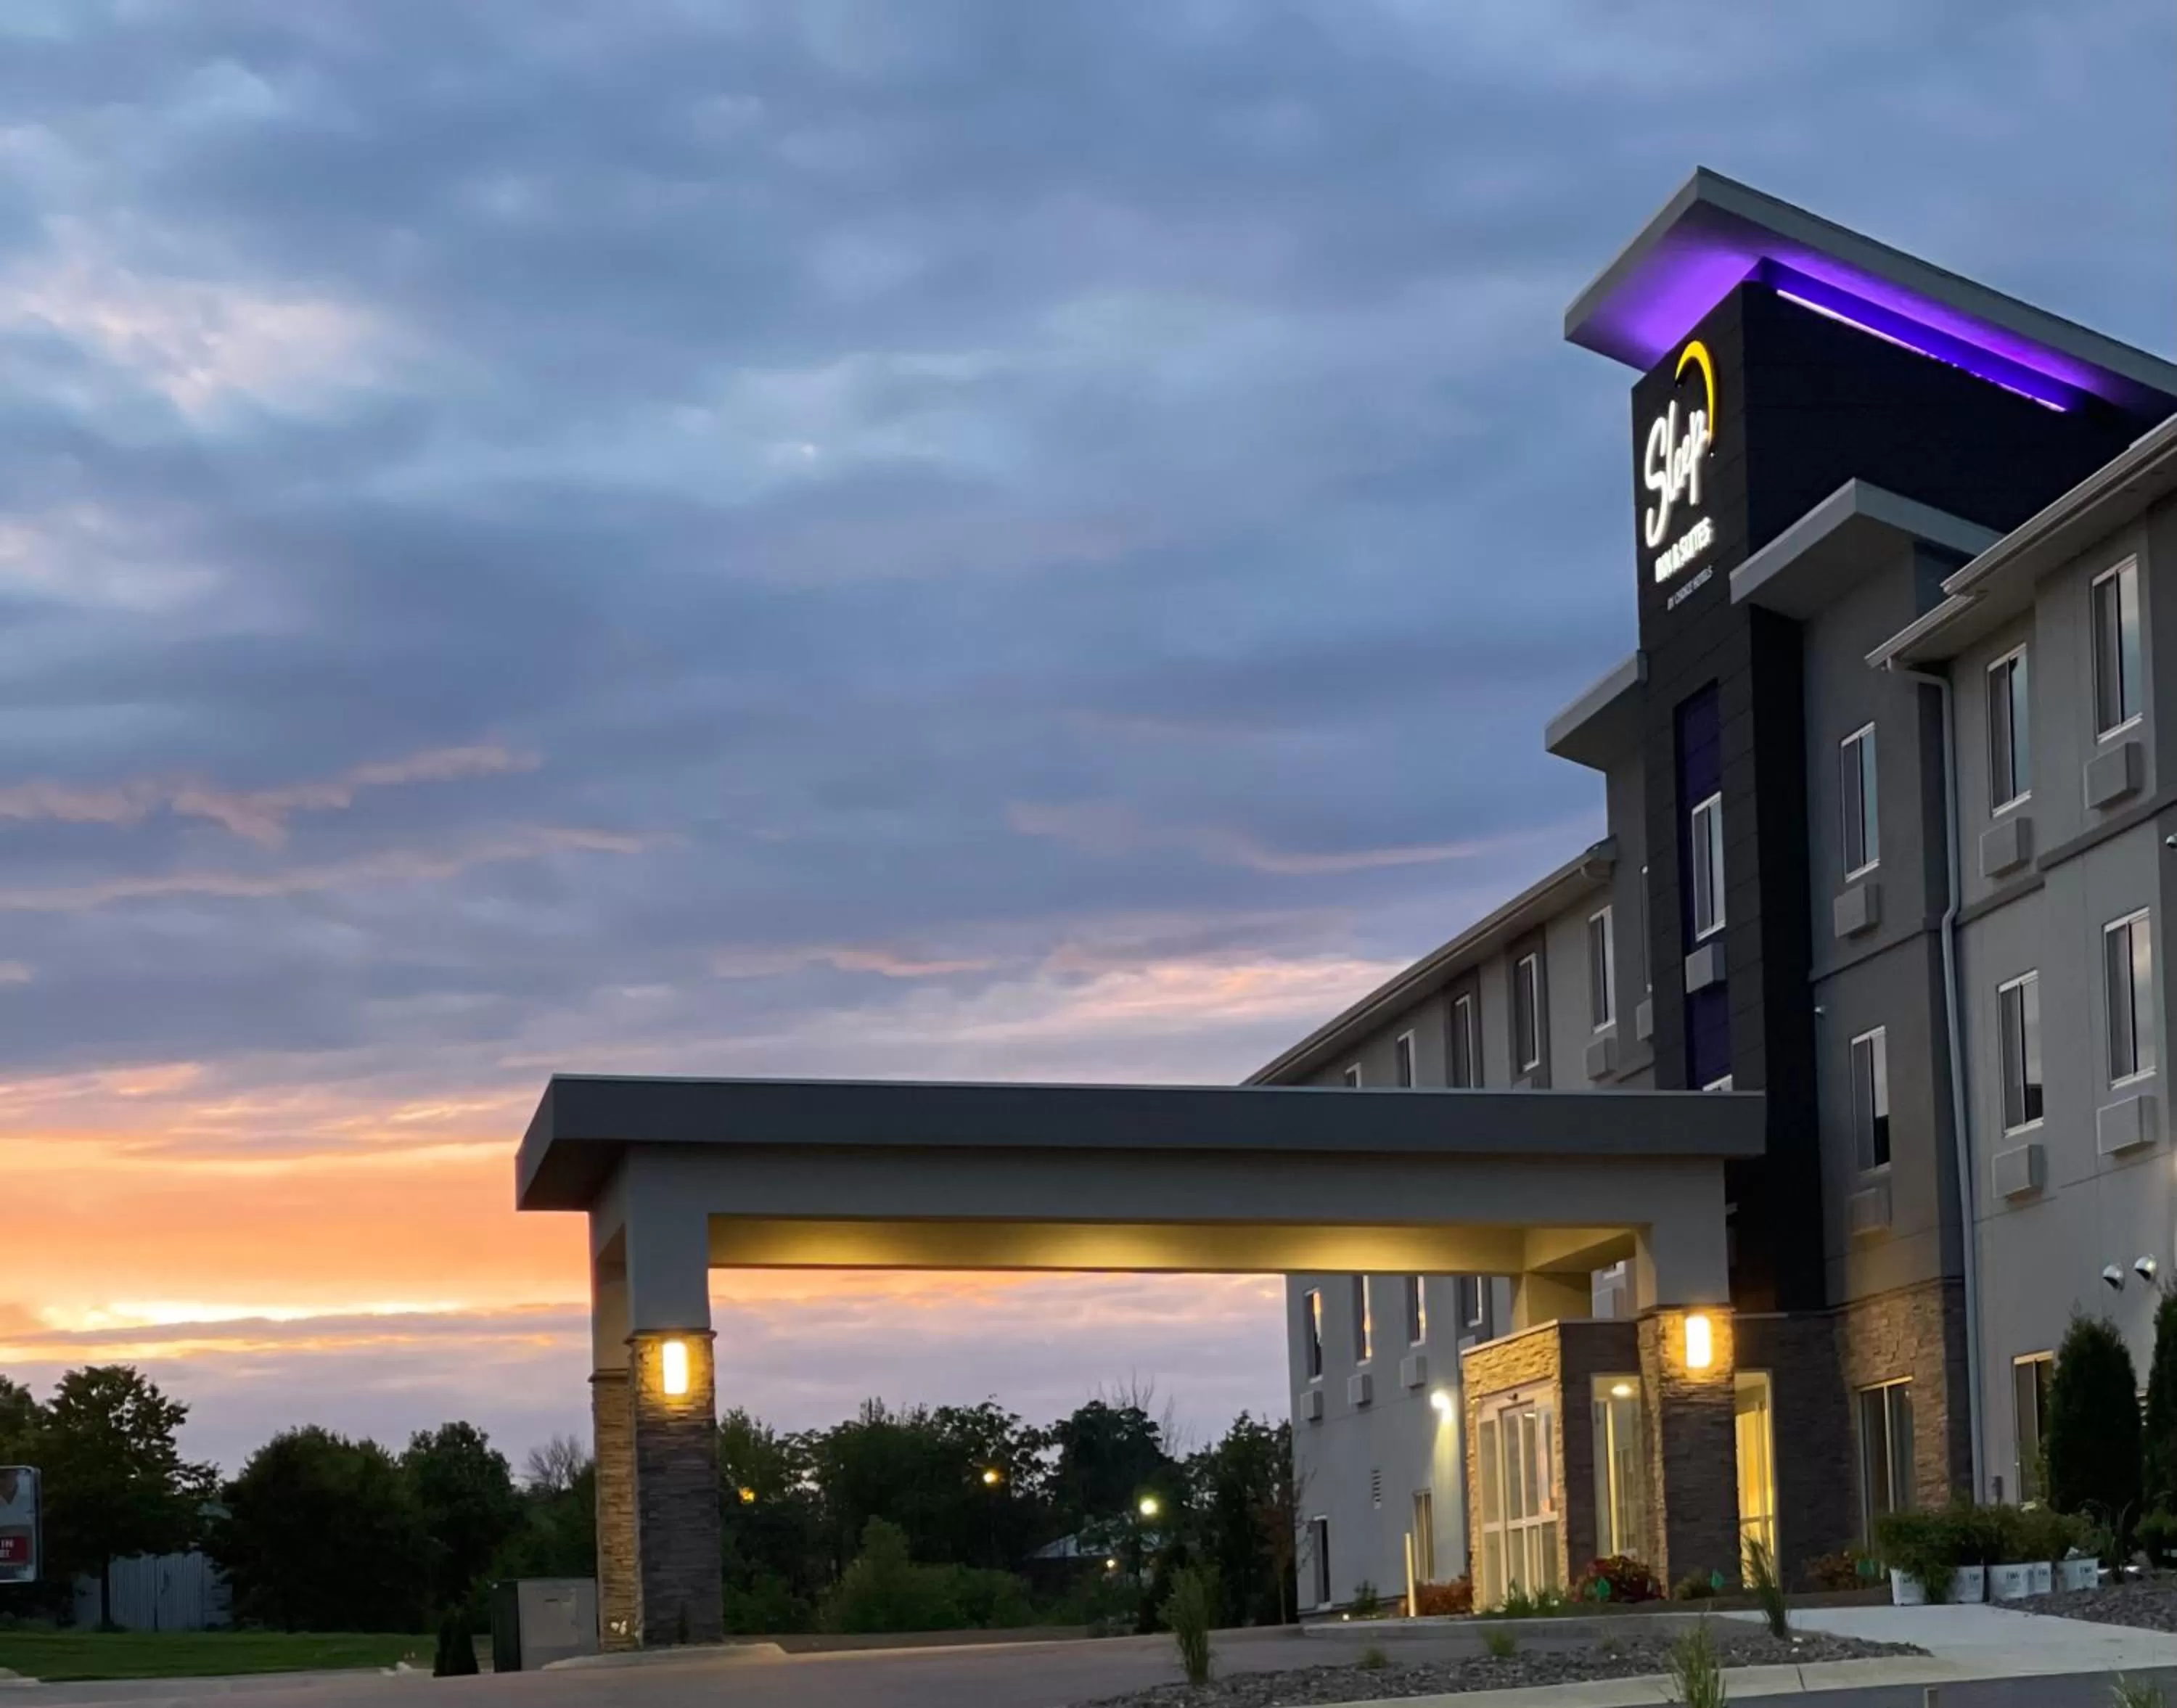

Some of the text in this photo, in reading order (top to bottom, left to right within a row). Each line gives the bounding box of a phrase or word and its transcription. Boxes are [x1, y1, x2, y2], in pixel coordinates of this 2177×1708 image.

[1644, 401, 1709, 549] Sleep
[1655, 549, 1673, 582] INN
[1680, 517, 1712, 564] SUITES
